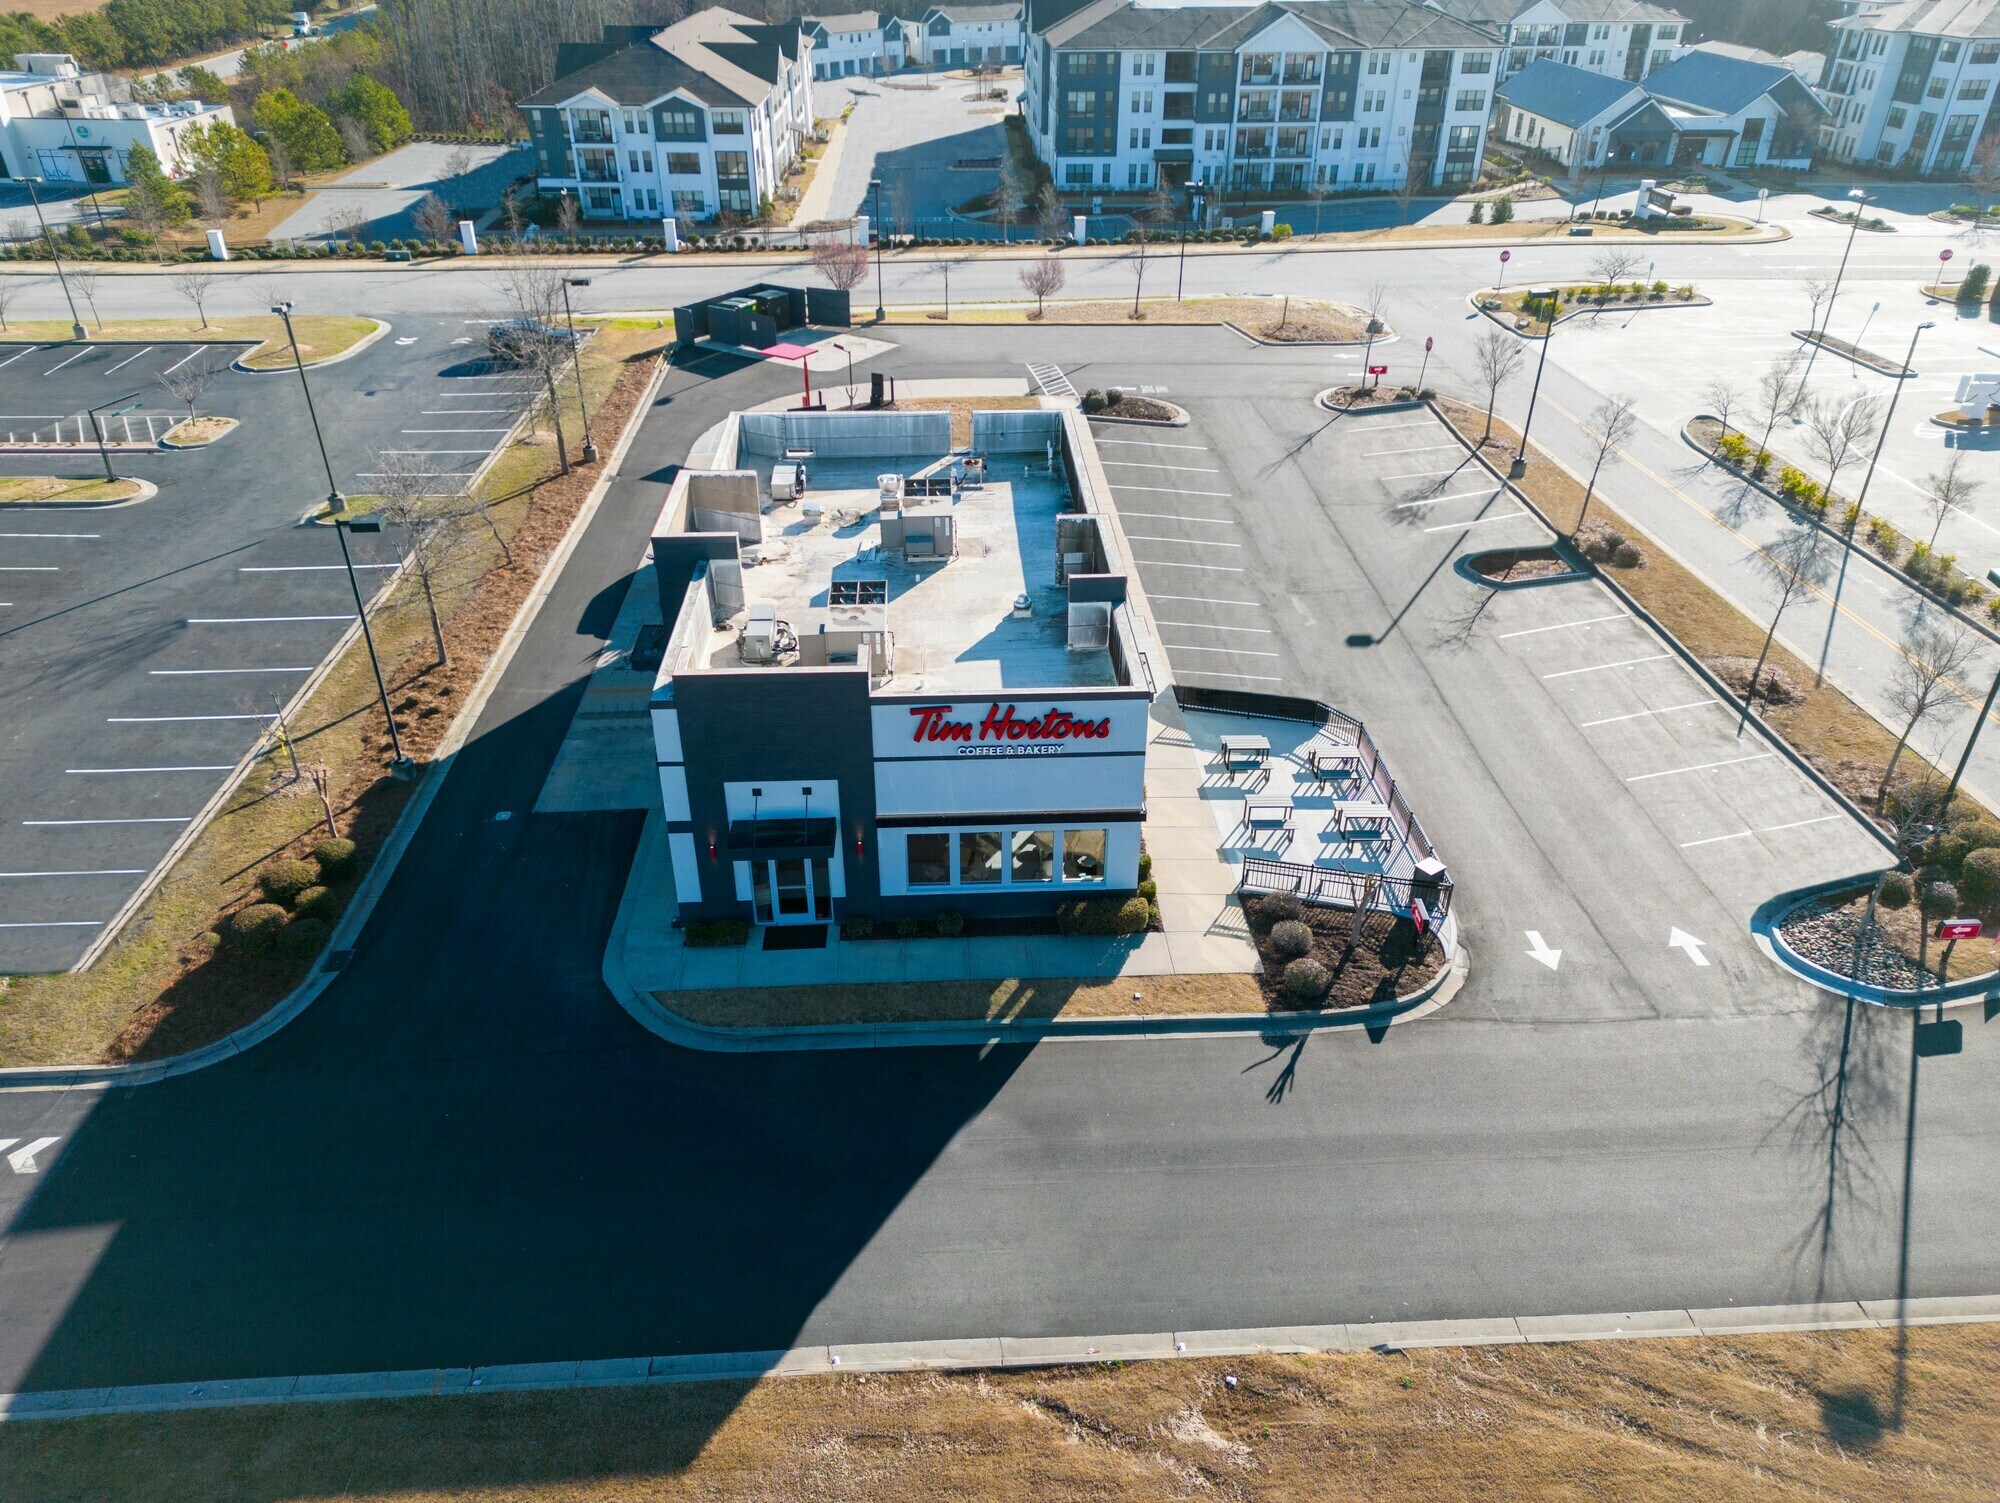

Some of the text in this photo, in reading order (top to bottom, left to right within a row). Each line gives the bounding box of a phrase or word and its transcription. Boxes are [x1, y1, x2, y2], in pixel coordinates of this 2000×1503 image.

[910, 702, 1110, 743] Tim Hortons
[957, 743, 1064, 756] COFFEE & BAKERY
